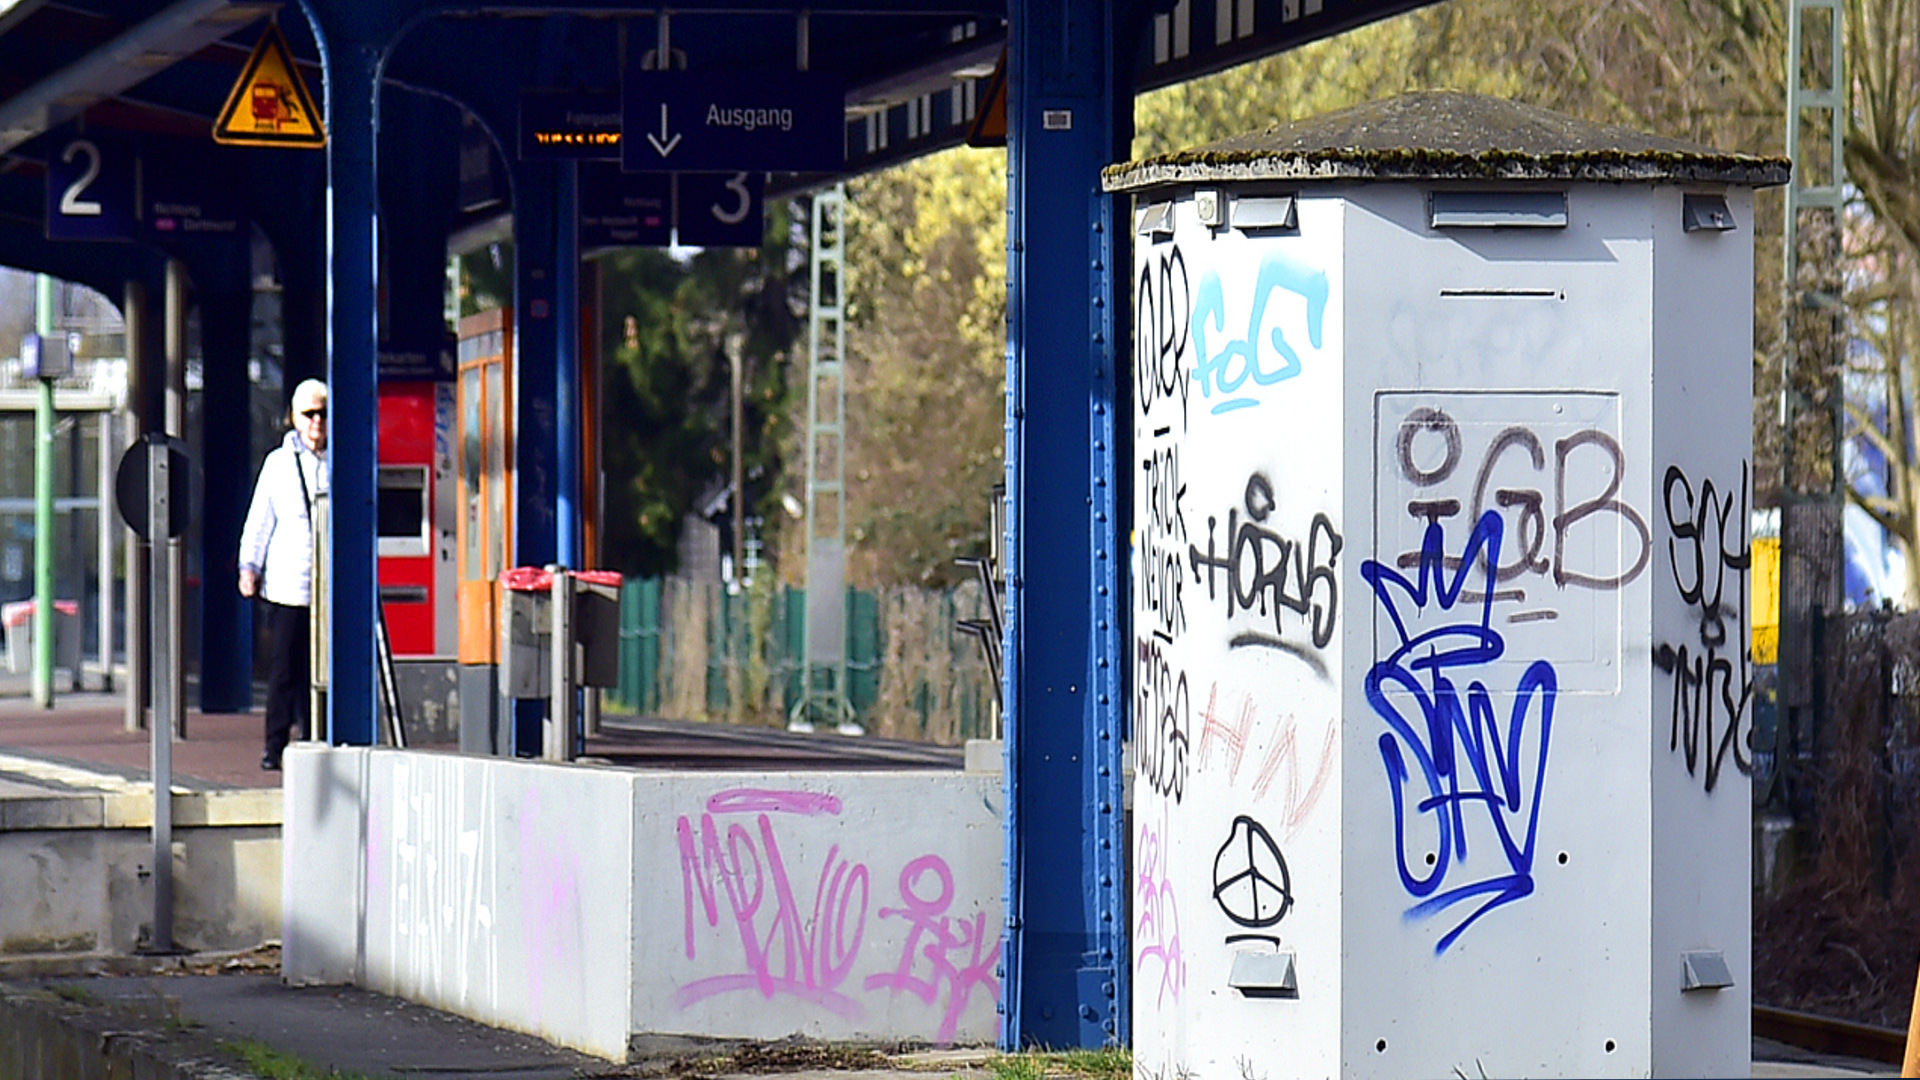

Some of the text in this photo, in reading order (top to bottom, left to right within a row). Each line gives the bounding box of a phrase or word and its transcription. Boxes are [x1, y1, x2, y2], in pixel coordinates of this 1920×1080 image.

[706, 102, 793, 132] Ausgang
[60, 140, 102, 214] 2
[710, 172, 752, 224] 3
